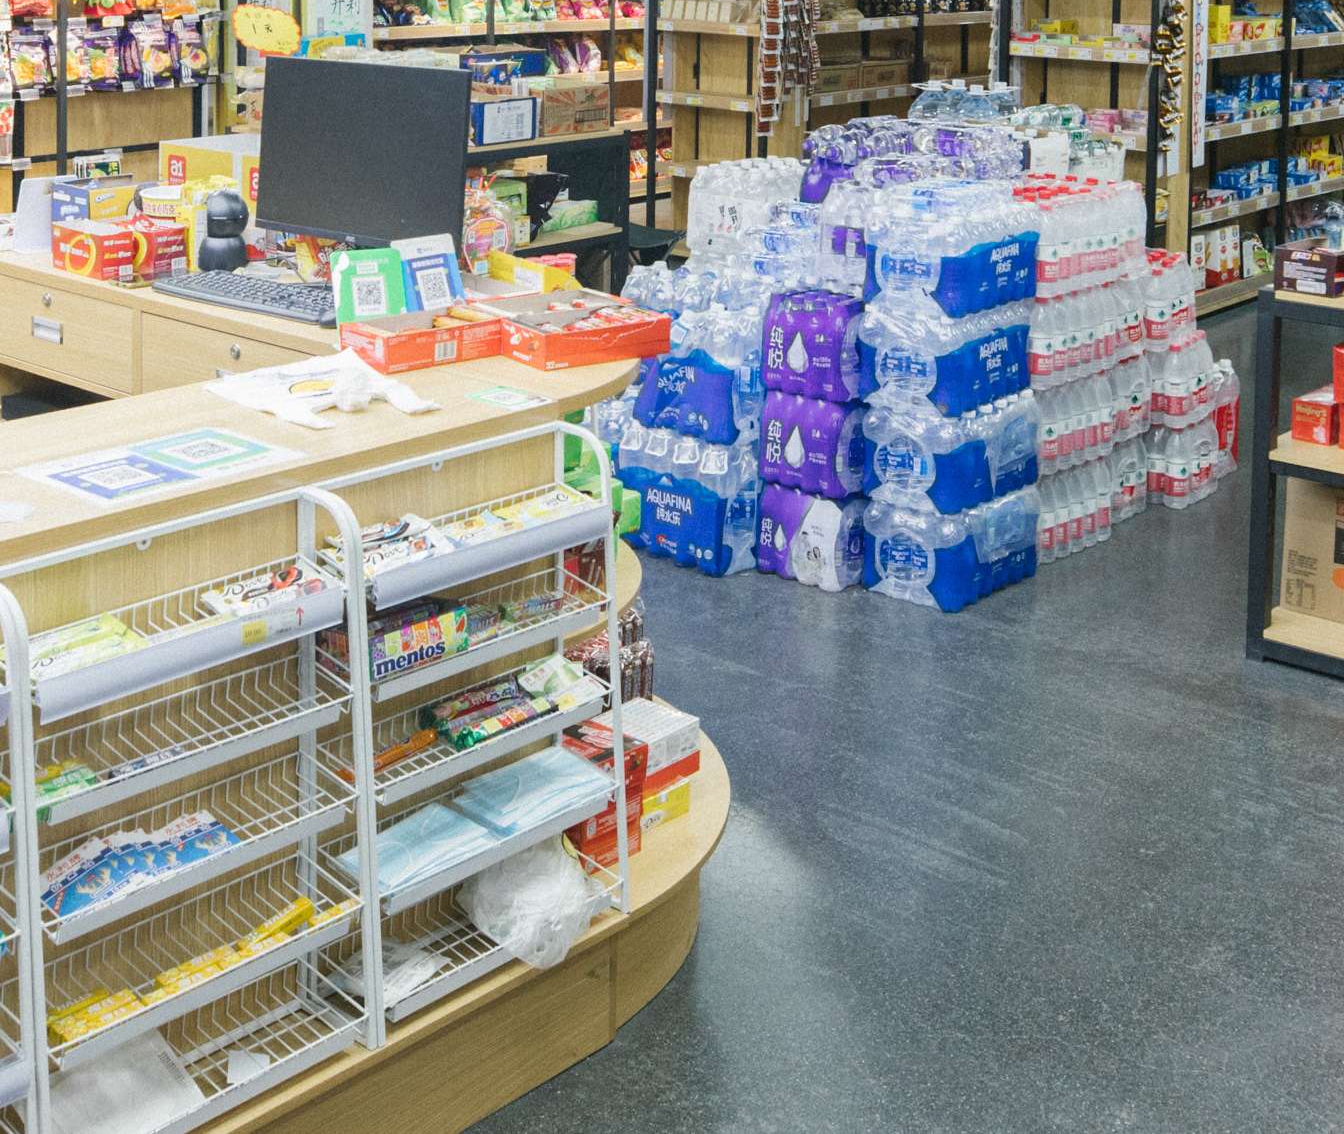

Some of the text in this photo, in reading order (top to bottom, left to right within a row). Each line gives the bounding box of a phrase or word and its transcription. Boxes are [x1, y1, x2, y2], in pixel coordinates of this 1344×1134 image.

[768, 325, 785, 371] 纯悦
[765, 419, 783, 465] 纯悦
[646, 488, 693, 516] AQUAFINA
[374, 641, 446, 679] mentos
